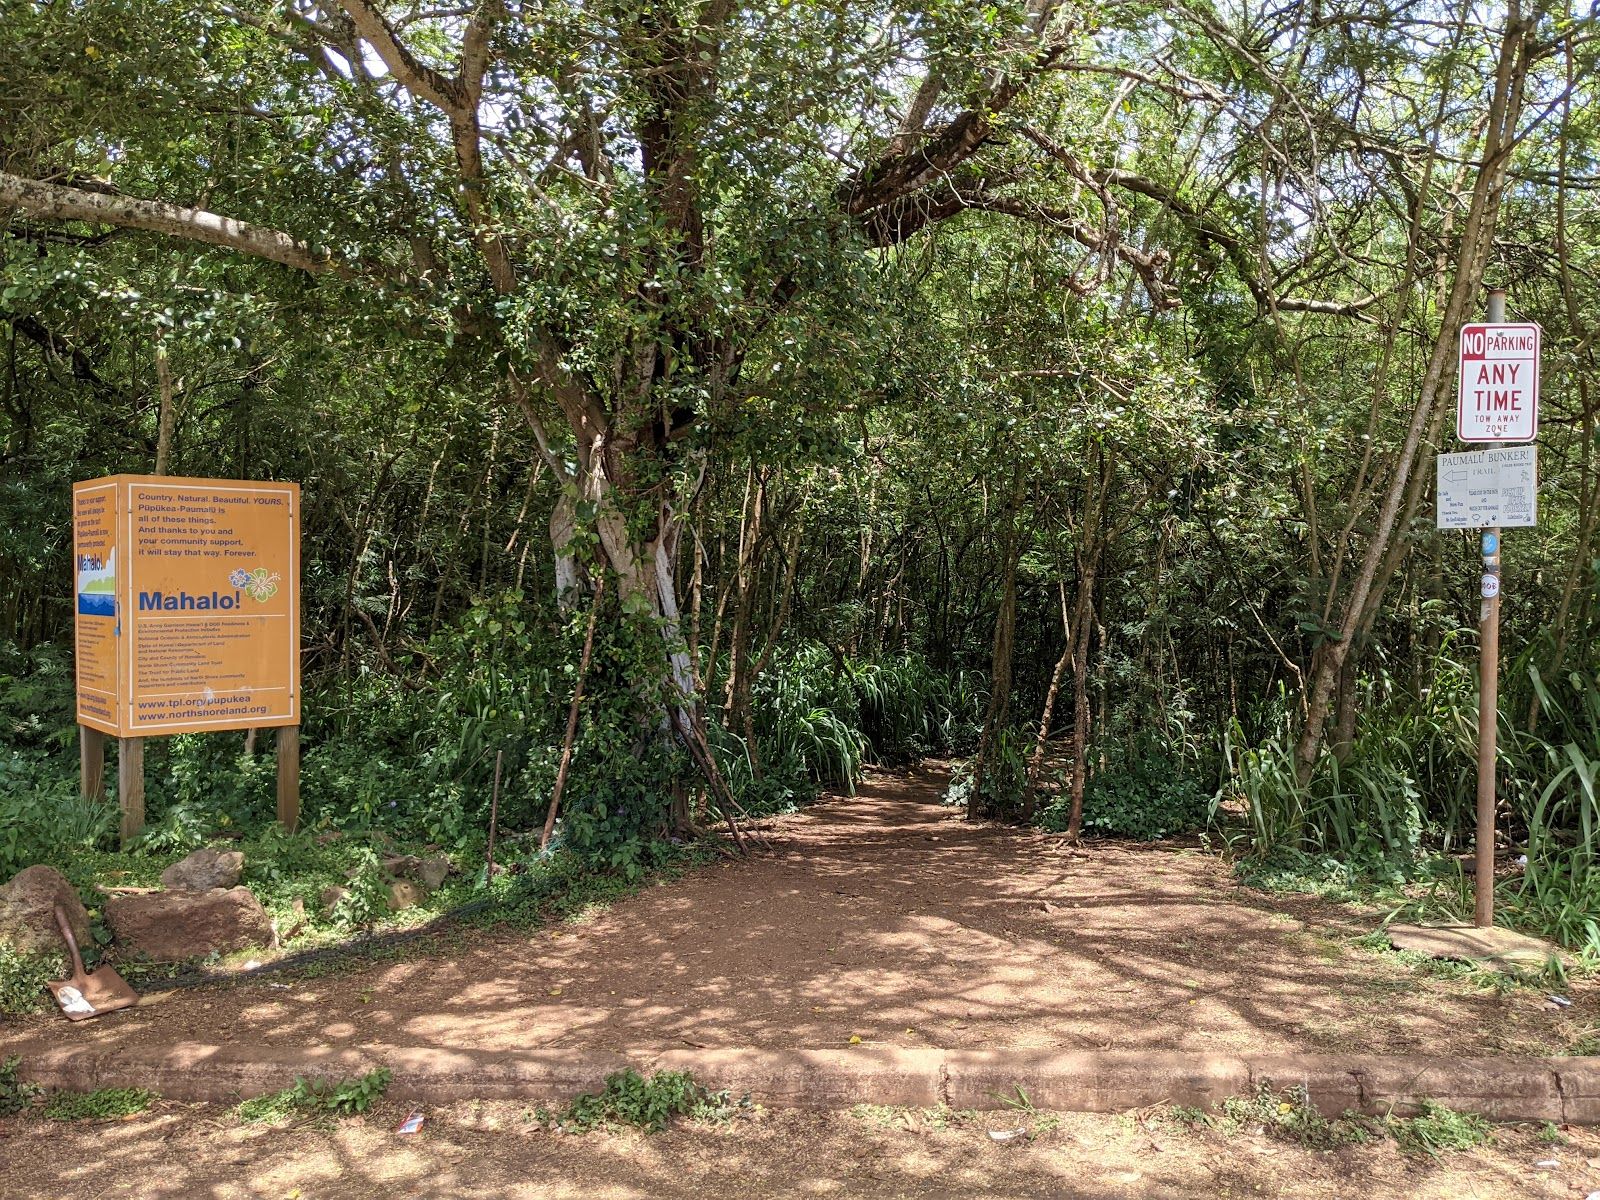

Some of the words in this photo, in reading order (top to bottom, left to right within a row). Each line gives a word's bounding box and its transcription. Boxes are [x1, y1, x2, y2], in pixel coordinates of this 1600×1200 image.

[1463, 333, 1484, 355] NO
[1487, 336, 1533, 351] PARKING
[1477, 364, 1521, 385] ANY
[1474, 390, 1522, 411] TIME
[1474, 415, 1491, 423] TOW
[1497, 414, 1520, 423] AWAY
[1486, 425, 1508, 433] ZONE
[253, 497, 284, 506] YOURS.
[162, 515, 186, 523] these
[188, 517, 217, 525] things.
[158, 526, 188, 534] thanks
[200, 528, 216, 536] you
[160, 538, 208, 546] community
[147, 548, 162, 556] will
[164, 549, 183, 557] stay
[203, 550, 222, 558] way.
[224, 549, 257, 557] Forever.
[77, 552, 103, 572] Mahalo!
[138, 590, 241, 611] Mahalo!
[138, 695, 251, 709] www.tpl.org/pupukea
[138, 704, 267, 721] www.northshoreland.org
